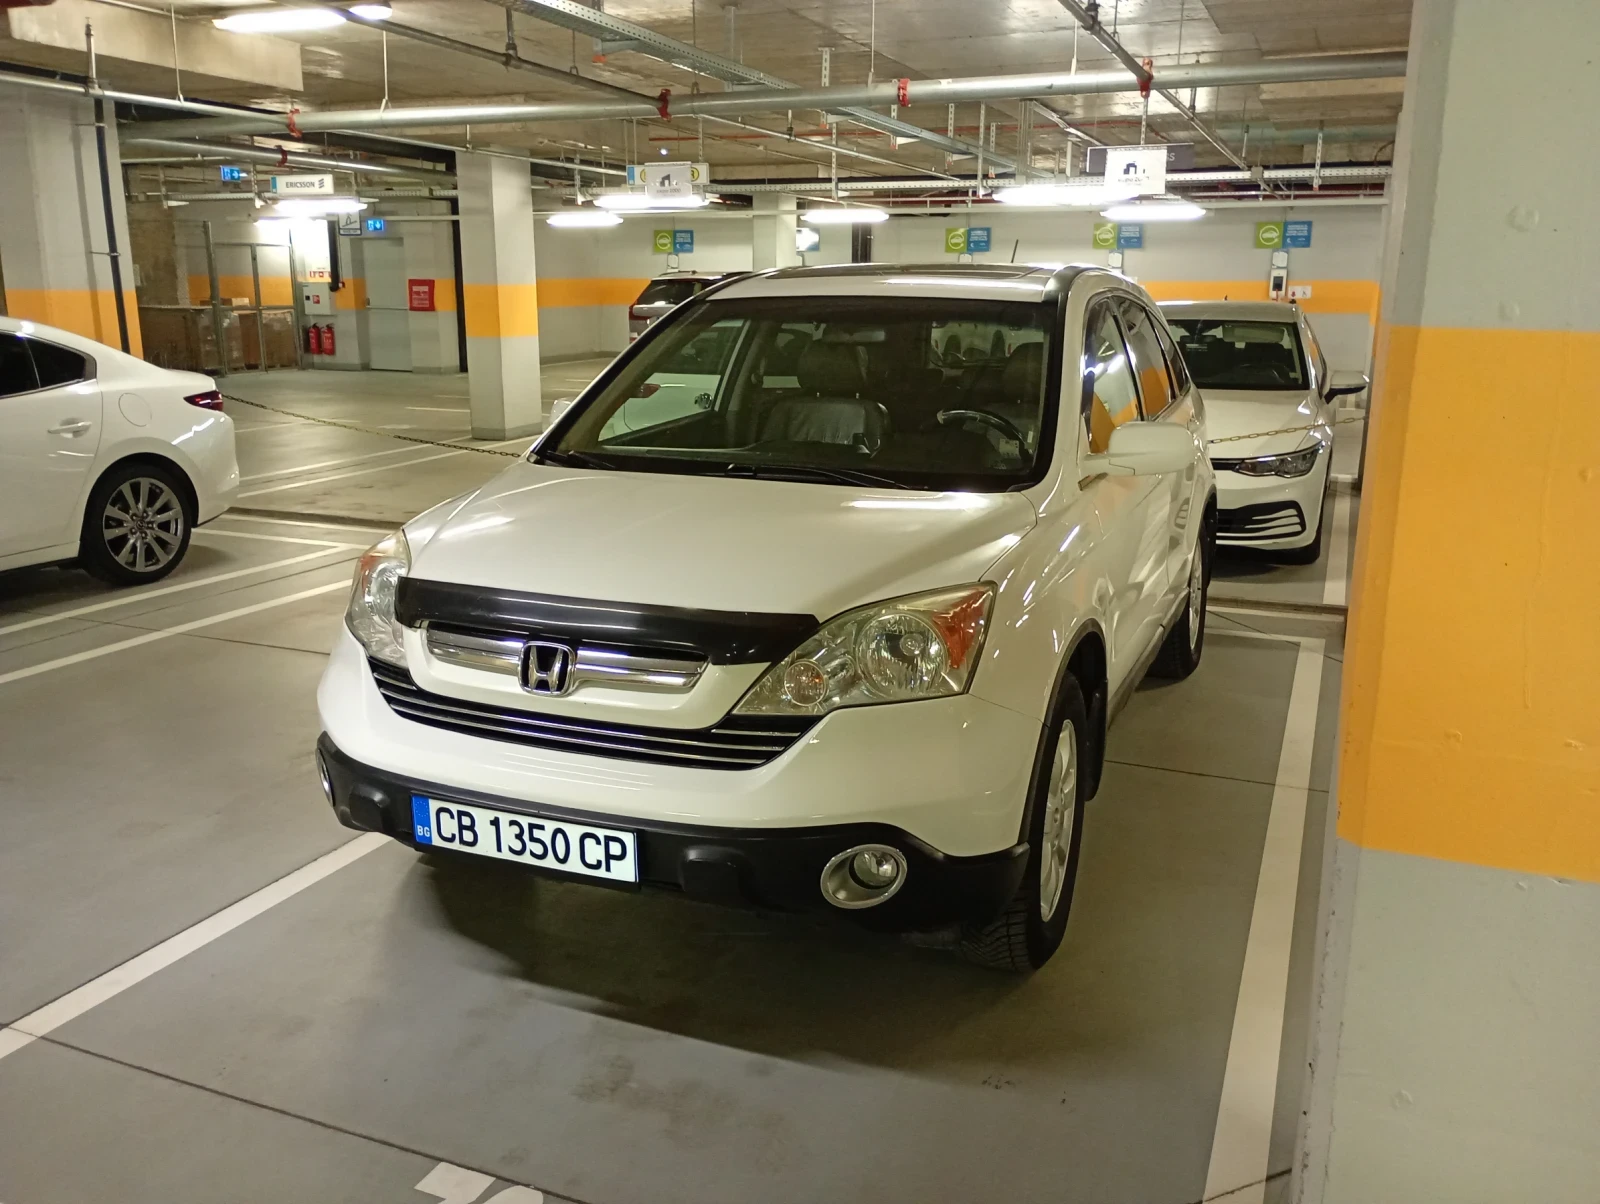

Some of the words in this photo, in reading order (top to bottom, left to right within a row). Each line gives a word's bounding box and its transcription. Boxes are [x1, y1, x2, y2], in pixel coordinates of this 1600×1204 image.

[285, 181, 316, 189] ERICSSON
[416, 825, 431, 838] BG
[435, 807, 479, 848] CB
[489, 816, 571, 865] 1350
[579, 831, 628, 873] CP
